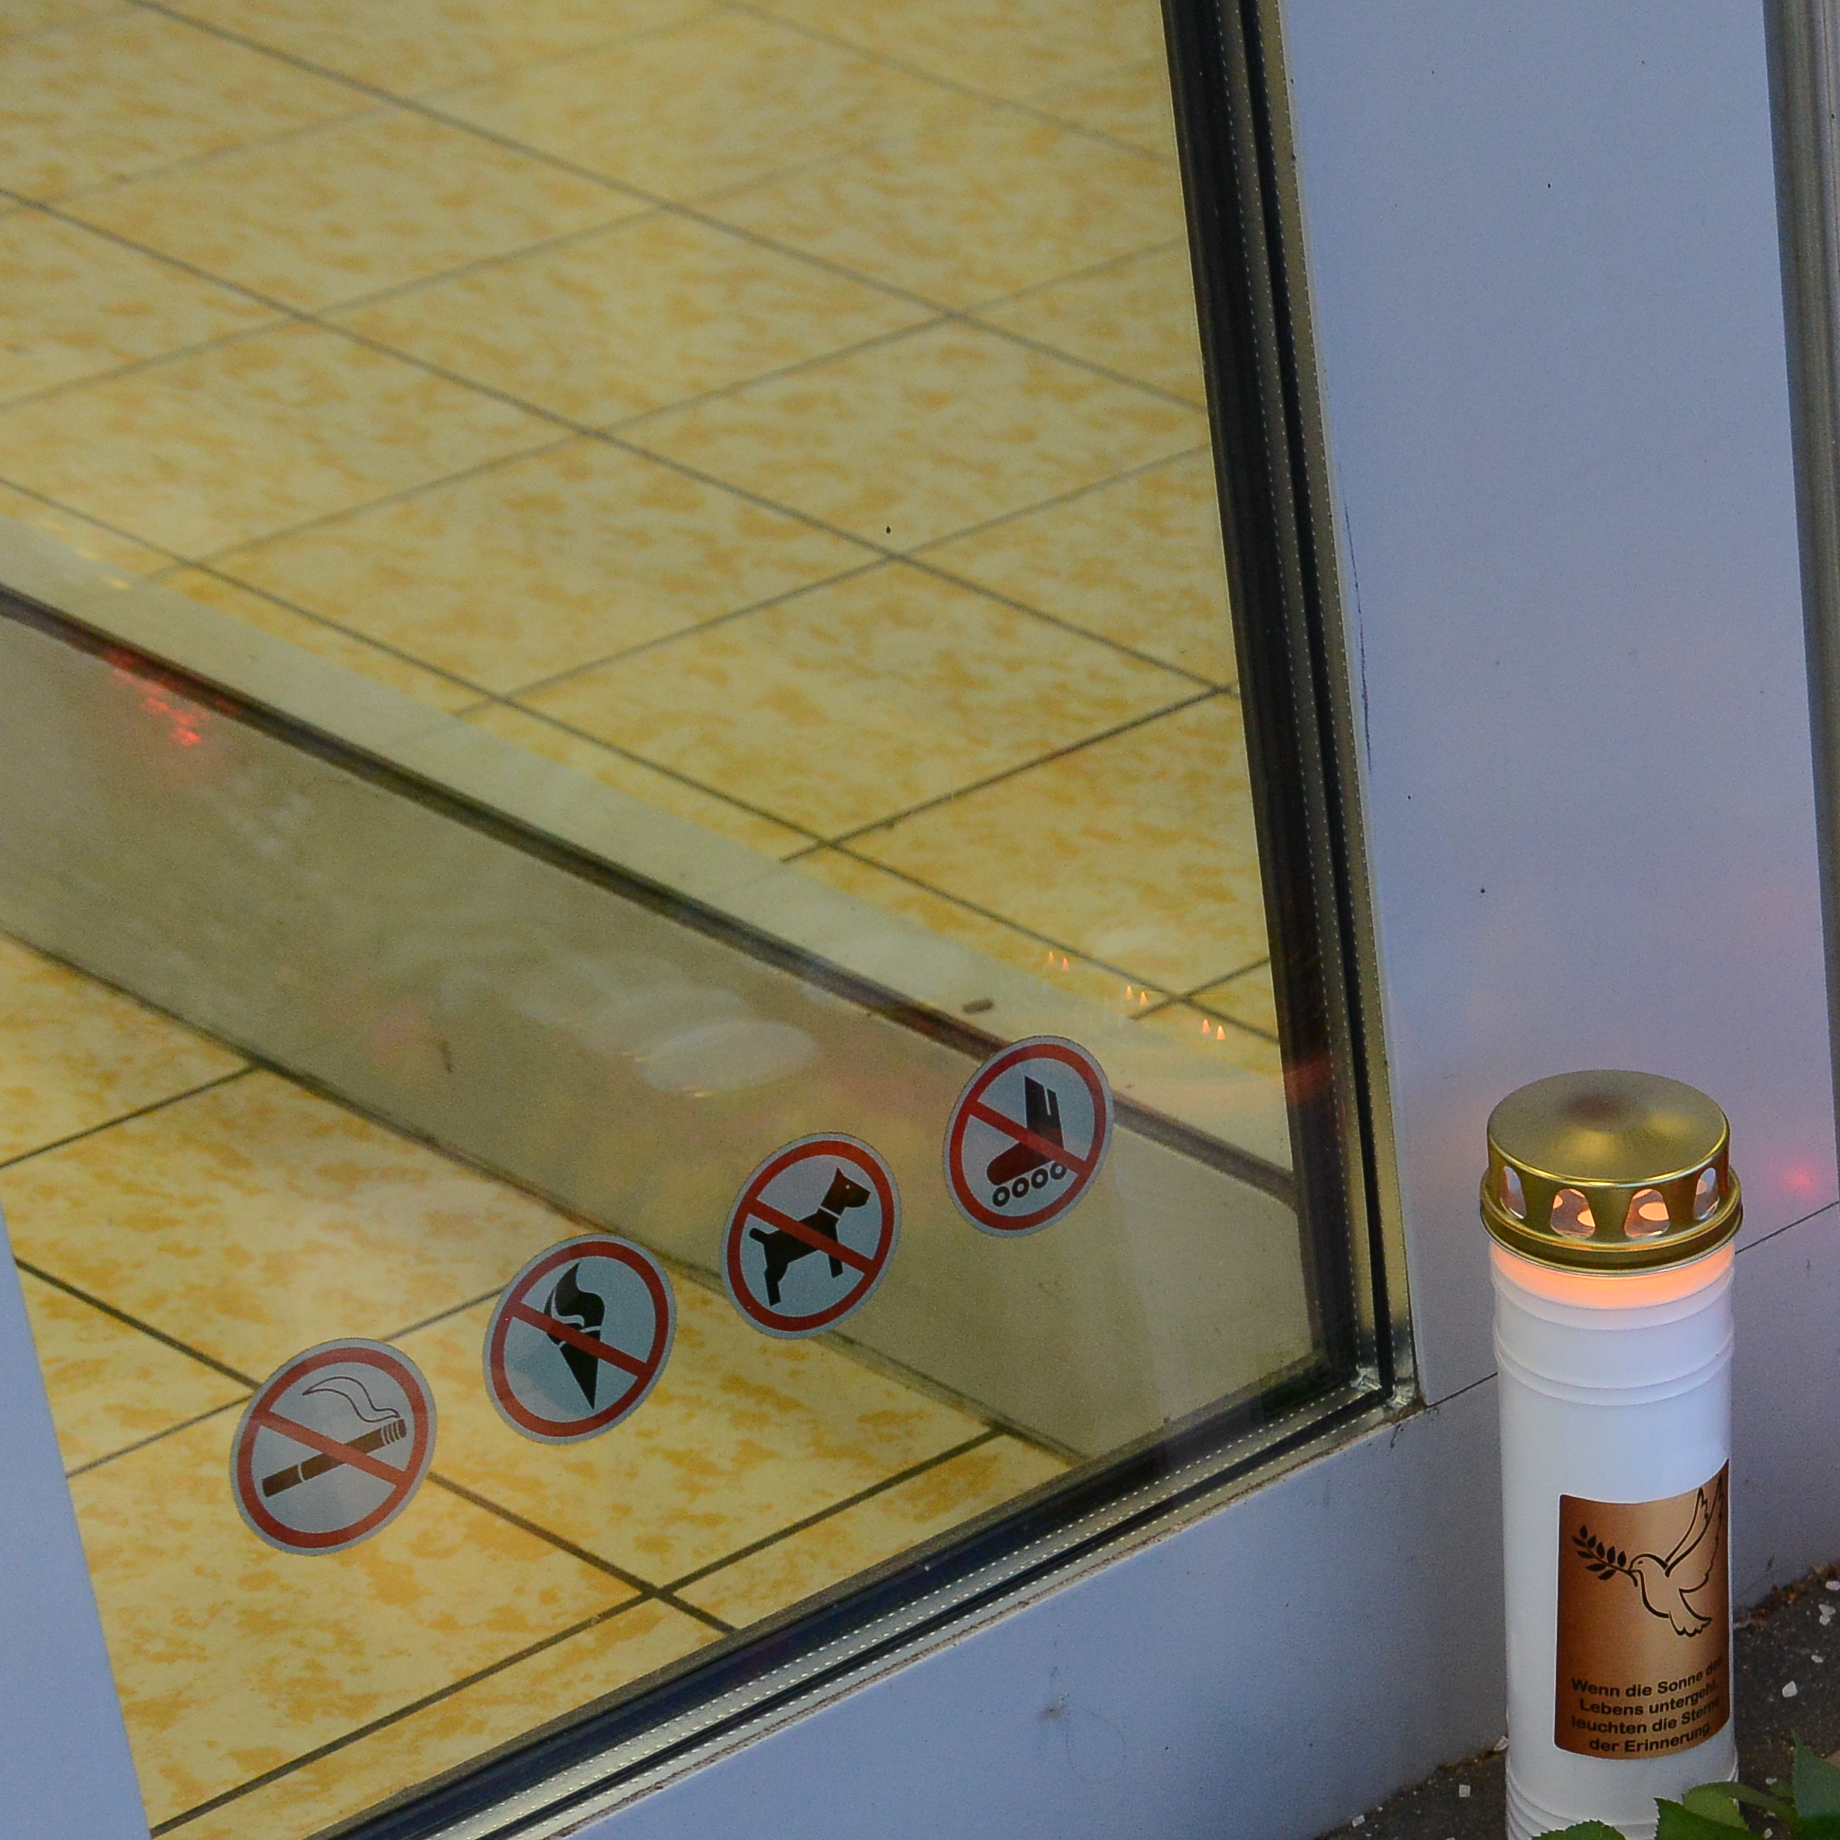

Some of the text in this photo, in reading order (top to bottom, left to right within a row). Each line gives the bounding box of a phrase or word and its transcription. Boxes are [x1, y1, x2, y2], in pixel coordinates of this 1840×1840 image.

[1571, 1678, 1620, 1697] Wenn
[1626, 1684, 1652, 1697] die
[1657, 1671, 1702, 1694] Sonne
[1571, 1698, 1720, 1734] leuchten die Sterne
[1580, 1698, 1643, 1716] Lebens
[1589, 1738, 1619, 1752] der
